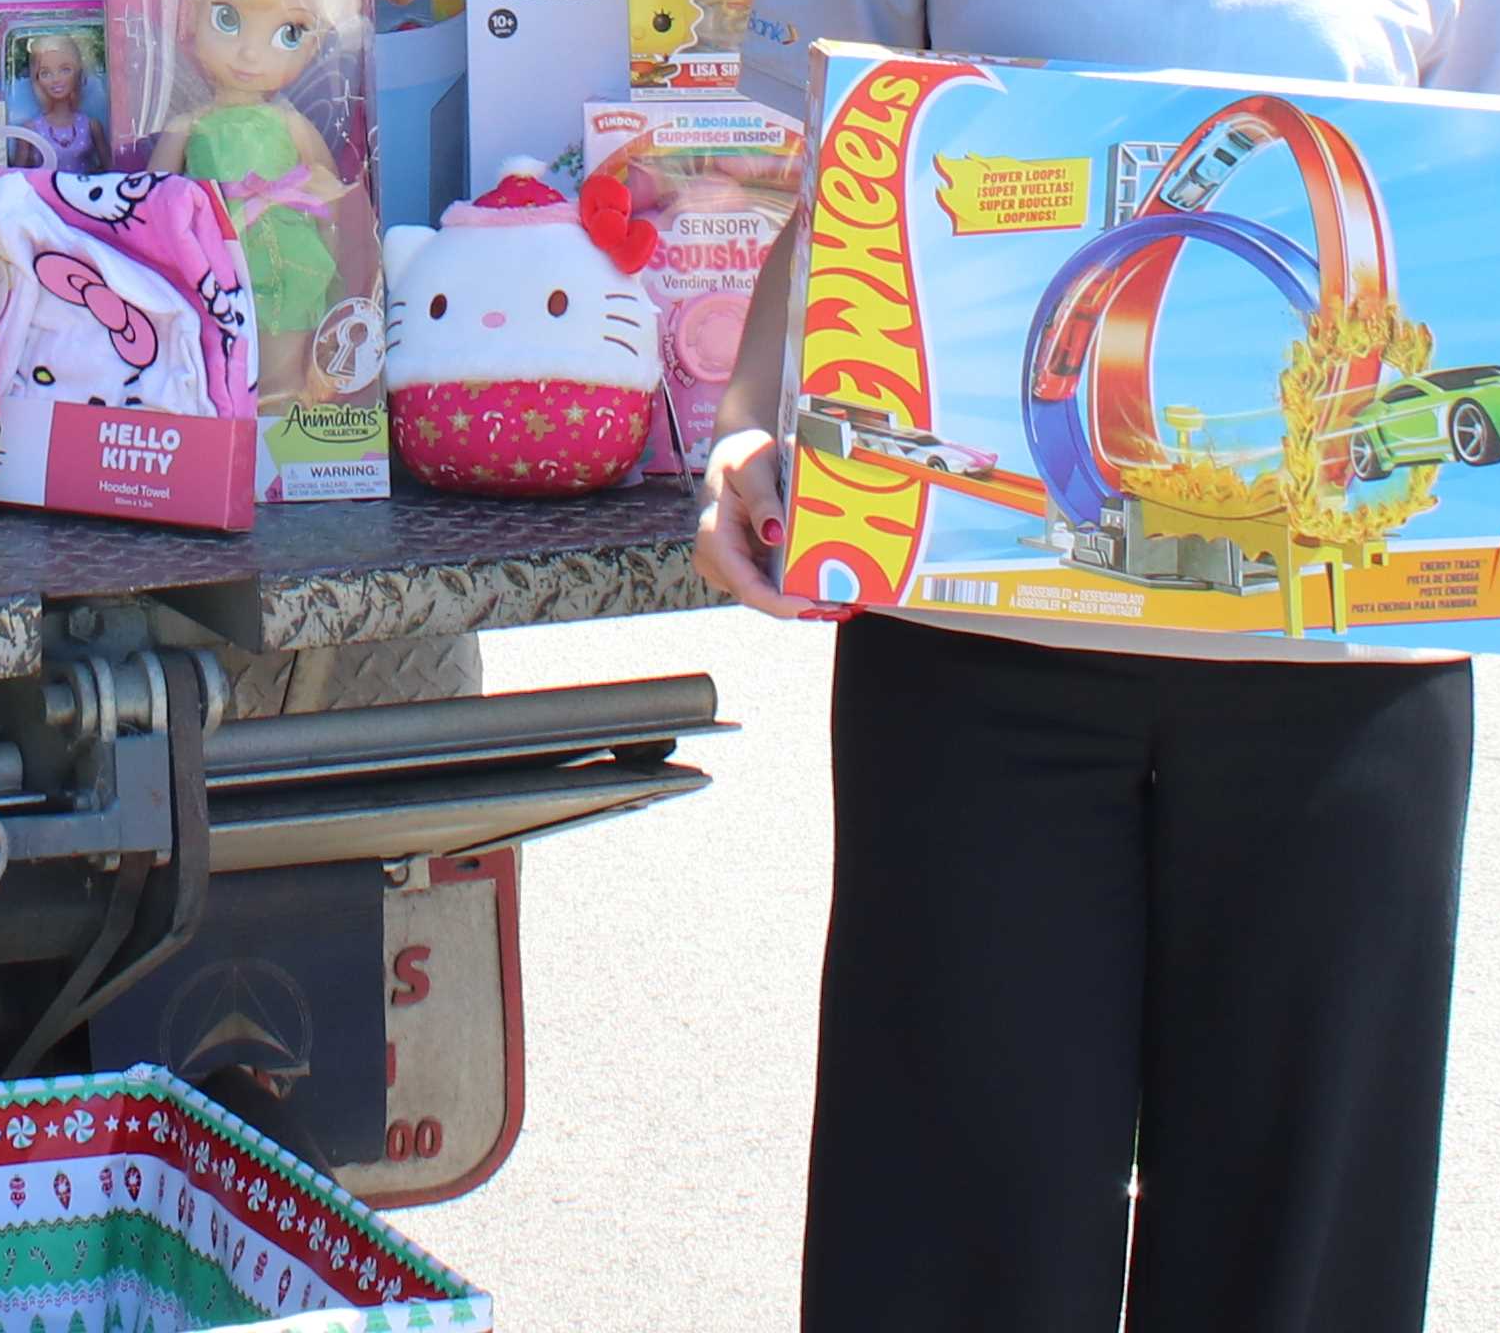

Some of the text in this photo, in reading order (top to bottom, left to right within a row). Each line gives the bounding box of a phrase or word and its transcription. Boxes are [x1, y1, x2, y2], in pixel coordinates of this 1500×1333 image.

[491, 15, 515, 28] 10+
[689, 63, 718, 77] LISA
[693, 116, 764, 129] ADORABLE
[656, 131, 730, 144] SURPRISES
[982, 168, 1066, 183] POWER LOOPS!
[1020, 182, 1074, 195] VUELTAS!
[979, 196, 1073, 211] SUPER BOUCLES!
[996, 210, 1057, 224] LOOPINGS!
[679, 219, 760, 235] SENSORY
[662, 274, 718, 292] Vending
[98, 421, 181, 451] HELLO
[101, 446, 174, 476] KITTY
[311, 465, 379, 478] WARNING:
[98, 480, 171, 500] Hooded Towel
[1017, 584, 1072, 599] UNASSEMBLED
